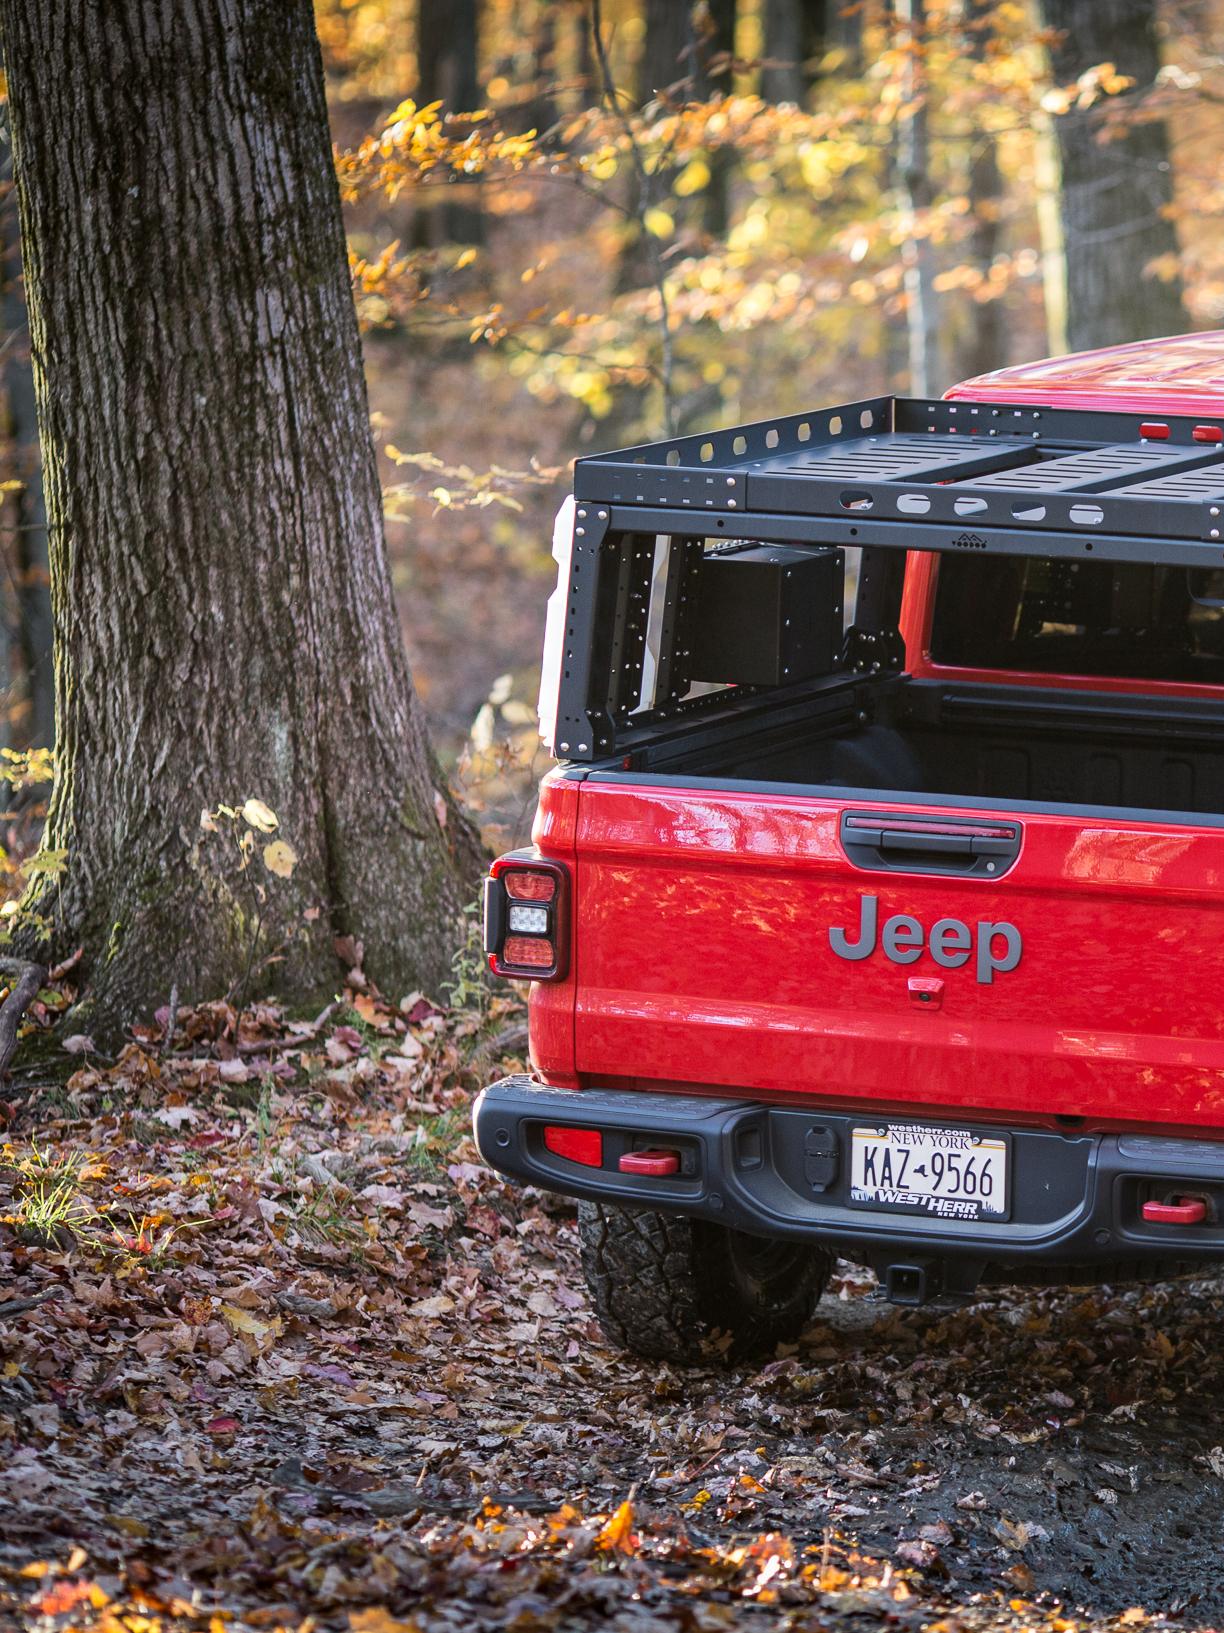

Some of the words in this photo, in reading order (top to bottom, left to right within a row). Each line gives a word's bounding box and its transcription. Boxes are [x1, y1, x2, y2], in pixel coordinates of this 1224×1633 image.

[829, 895, 1022, 984] Jeep
[888, 1124, 971, 1137] westherr.com
[891, 1132, 926, 1146] NEW
[930, 1135, 970, 1150] YORK
[864, 1146, 911, 1190] KAZ
[931, 1152, 993, 1197] 9566
